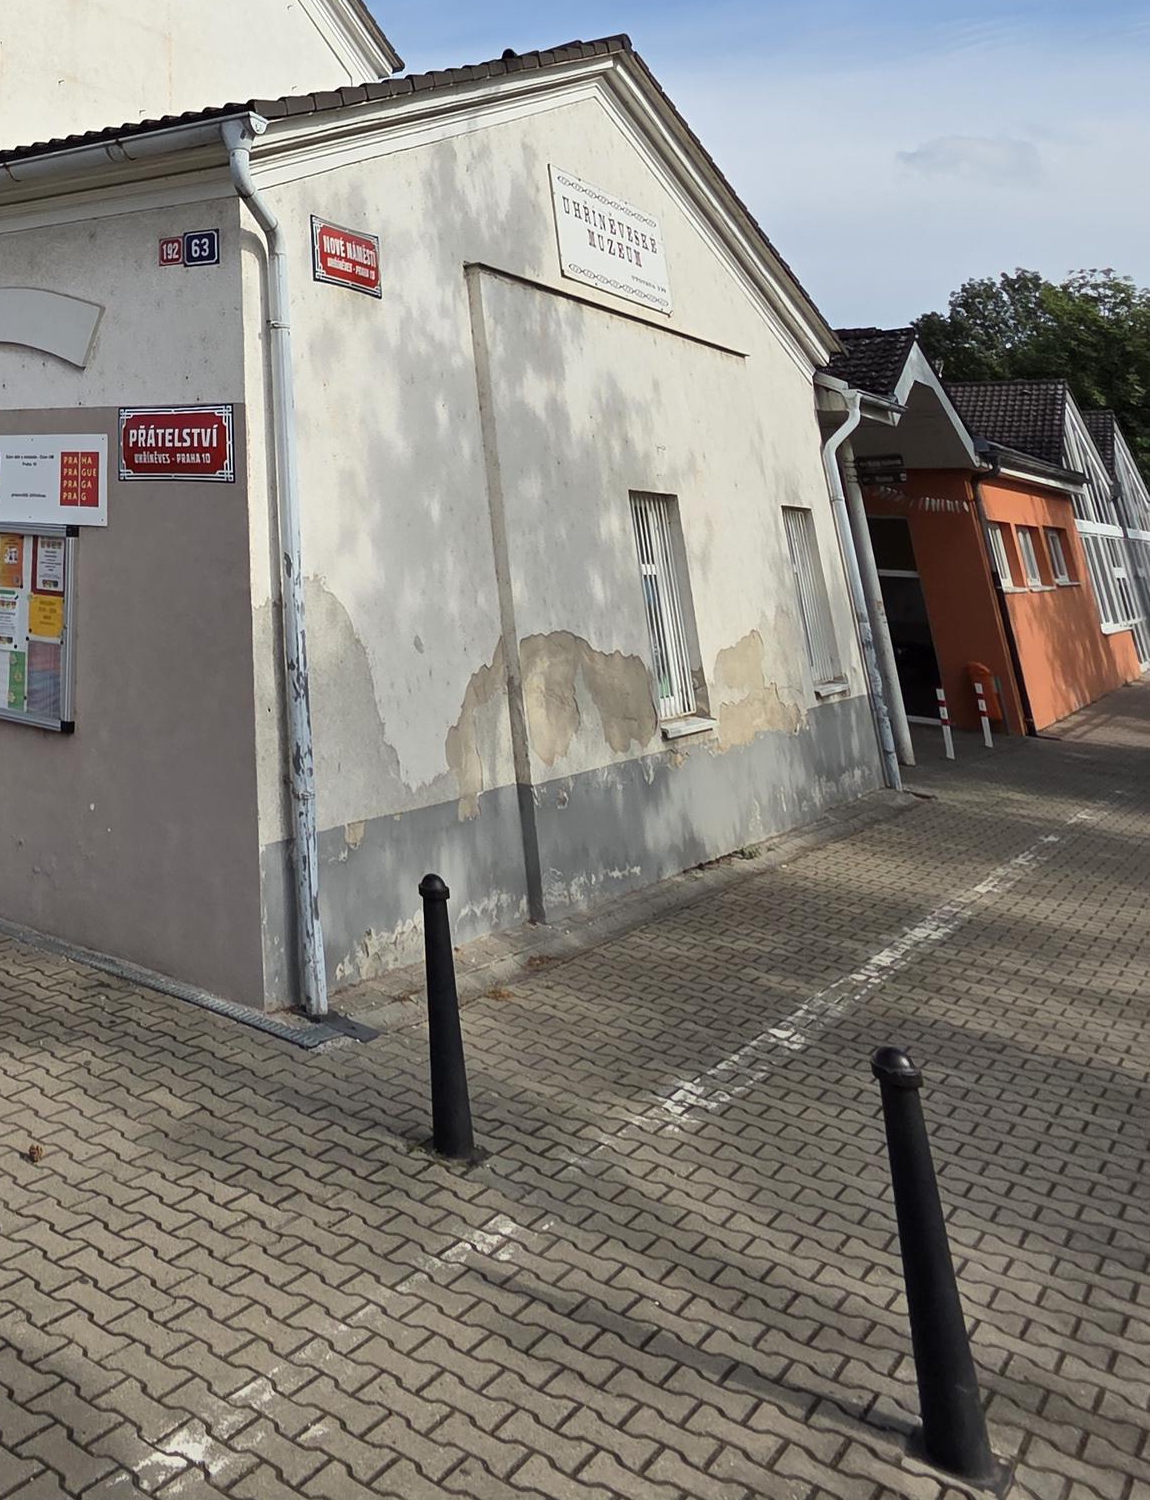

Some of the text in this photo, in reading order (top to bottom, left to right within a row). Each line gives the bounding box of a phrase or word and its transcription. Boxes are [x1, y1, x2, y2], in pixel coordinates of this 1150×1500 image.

[162, 242, 179, 260] 192
[191, 238, 209, 257] 63
[323, 235, 376, 268] NOVÉ NÁMĚSTÍ
[587, 228, 643, 267] MUZEUM
[129, 424, 218, 447] PŘÁTELSTVÍ
[63, 456, 78, 464] PRA
[81, 456, 92, 464] HA
[176, 453, 201, 464] PRAHA
[201, 453, 211, 464] 10
[63, 468, 97, 477] PRA GUE
[62, 480, 92, 488] PRA GA
[62, 491, 87, 500] PRA G
